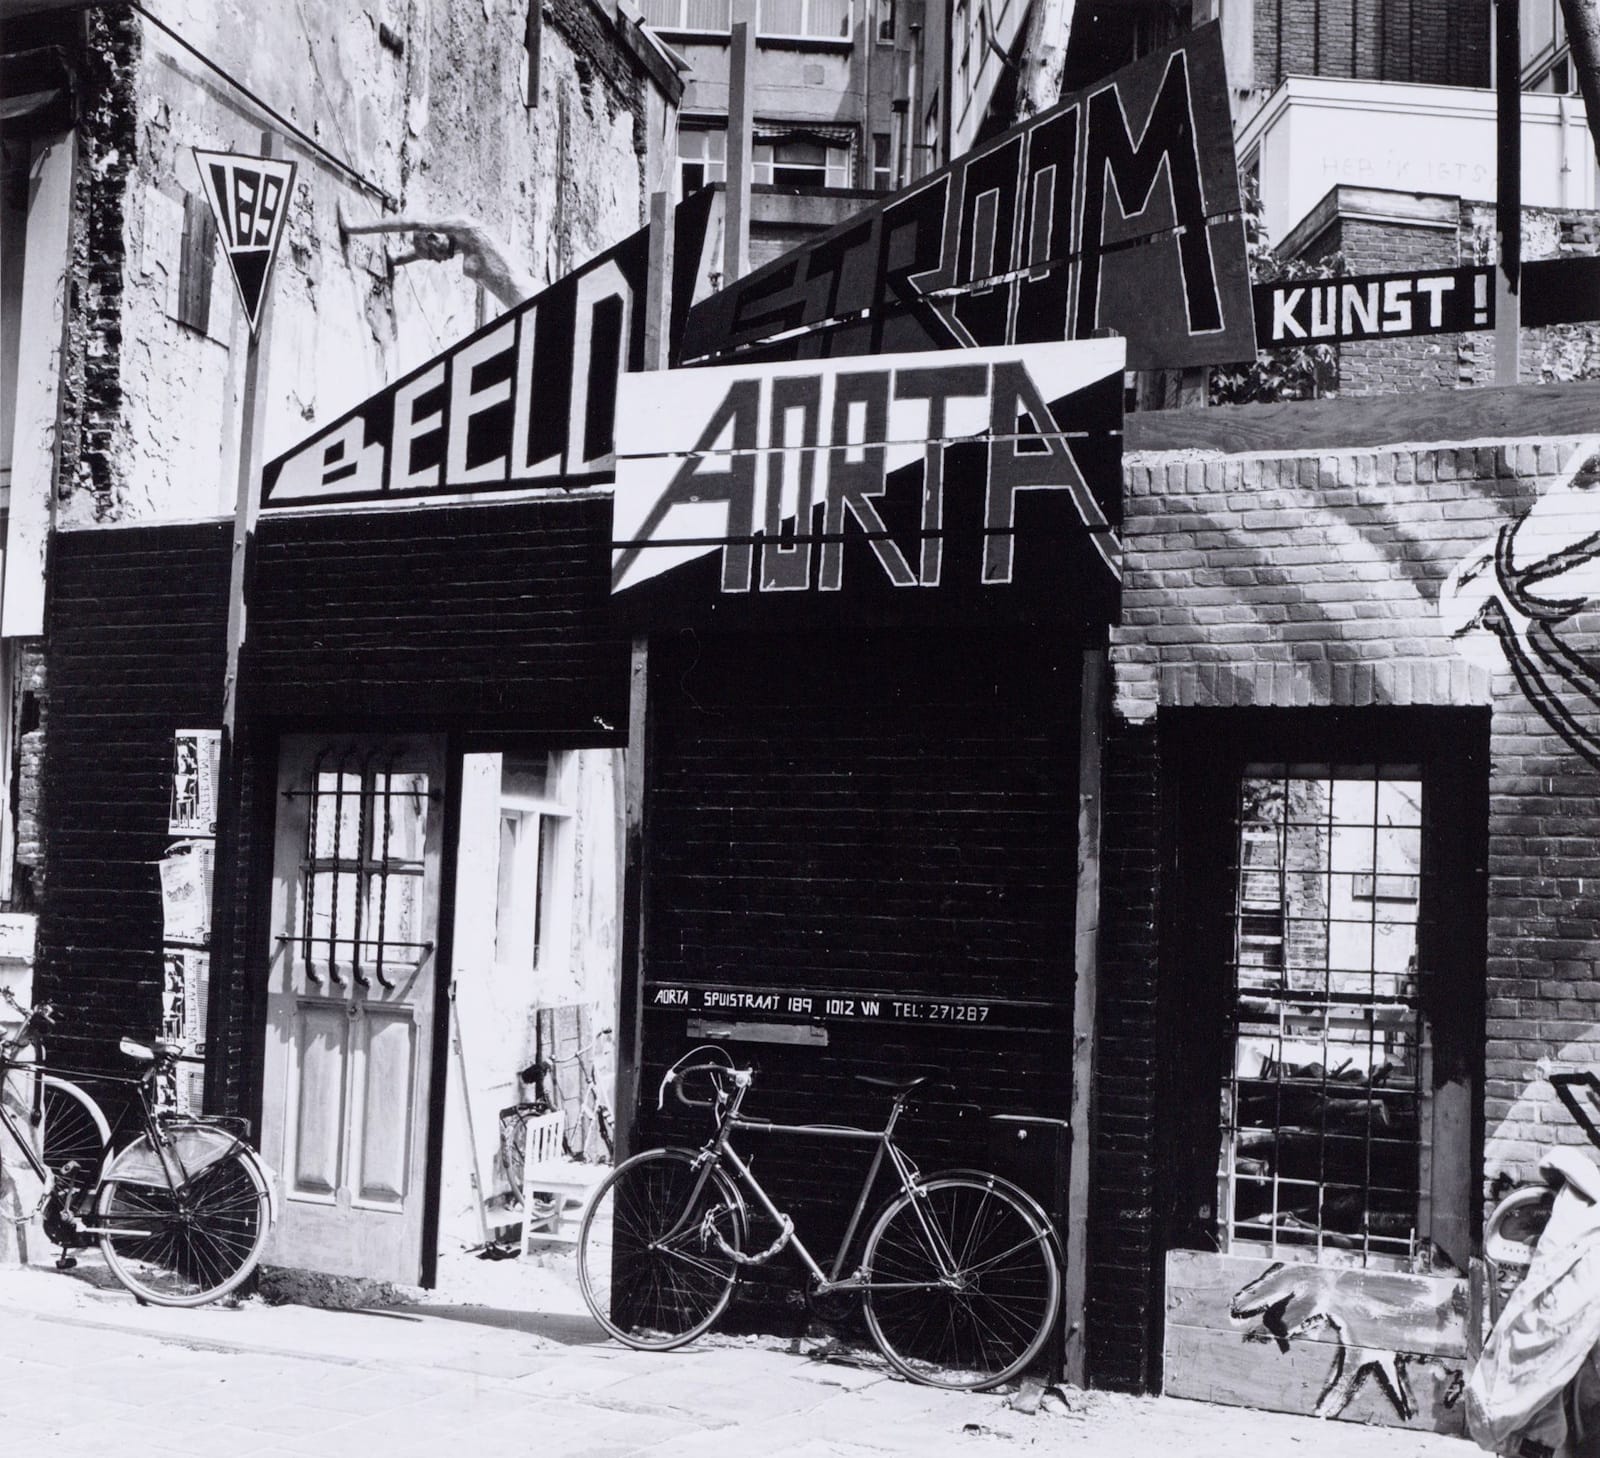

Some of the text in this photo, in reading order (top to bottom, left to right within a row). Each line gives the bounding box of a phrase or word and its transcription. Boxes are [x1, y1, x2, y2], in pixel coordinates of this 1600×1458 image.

[209, 163, 284, 247] 189
[704, 49, 1225, 362] STROOM
[268, 258, 633, 499] BEELD
[611, 359, 1123, 594] AORTA
[654, 989, 689, 1005] AORTA
[704, 991, 780, 1011] SPUISTRAAT
[788, 997, 812, 1013] 189
[826, 1000, 854, 1015] 1012
[862, 1002, 880, 1017] VN
[929, 1004, 990, 1022] 271287
